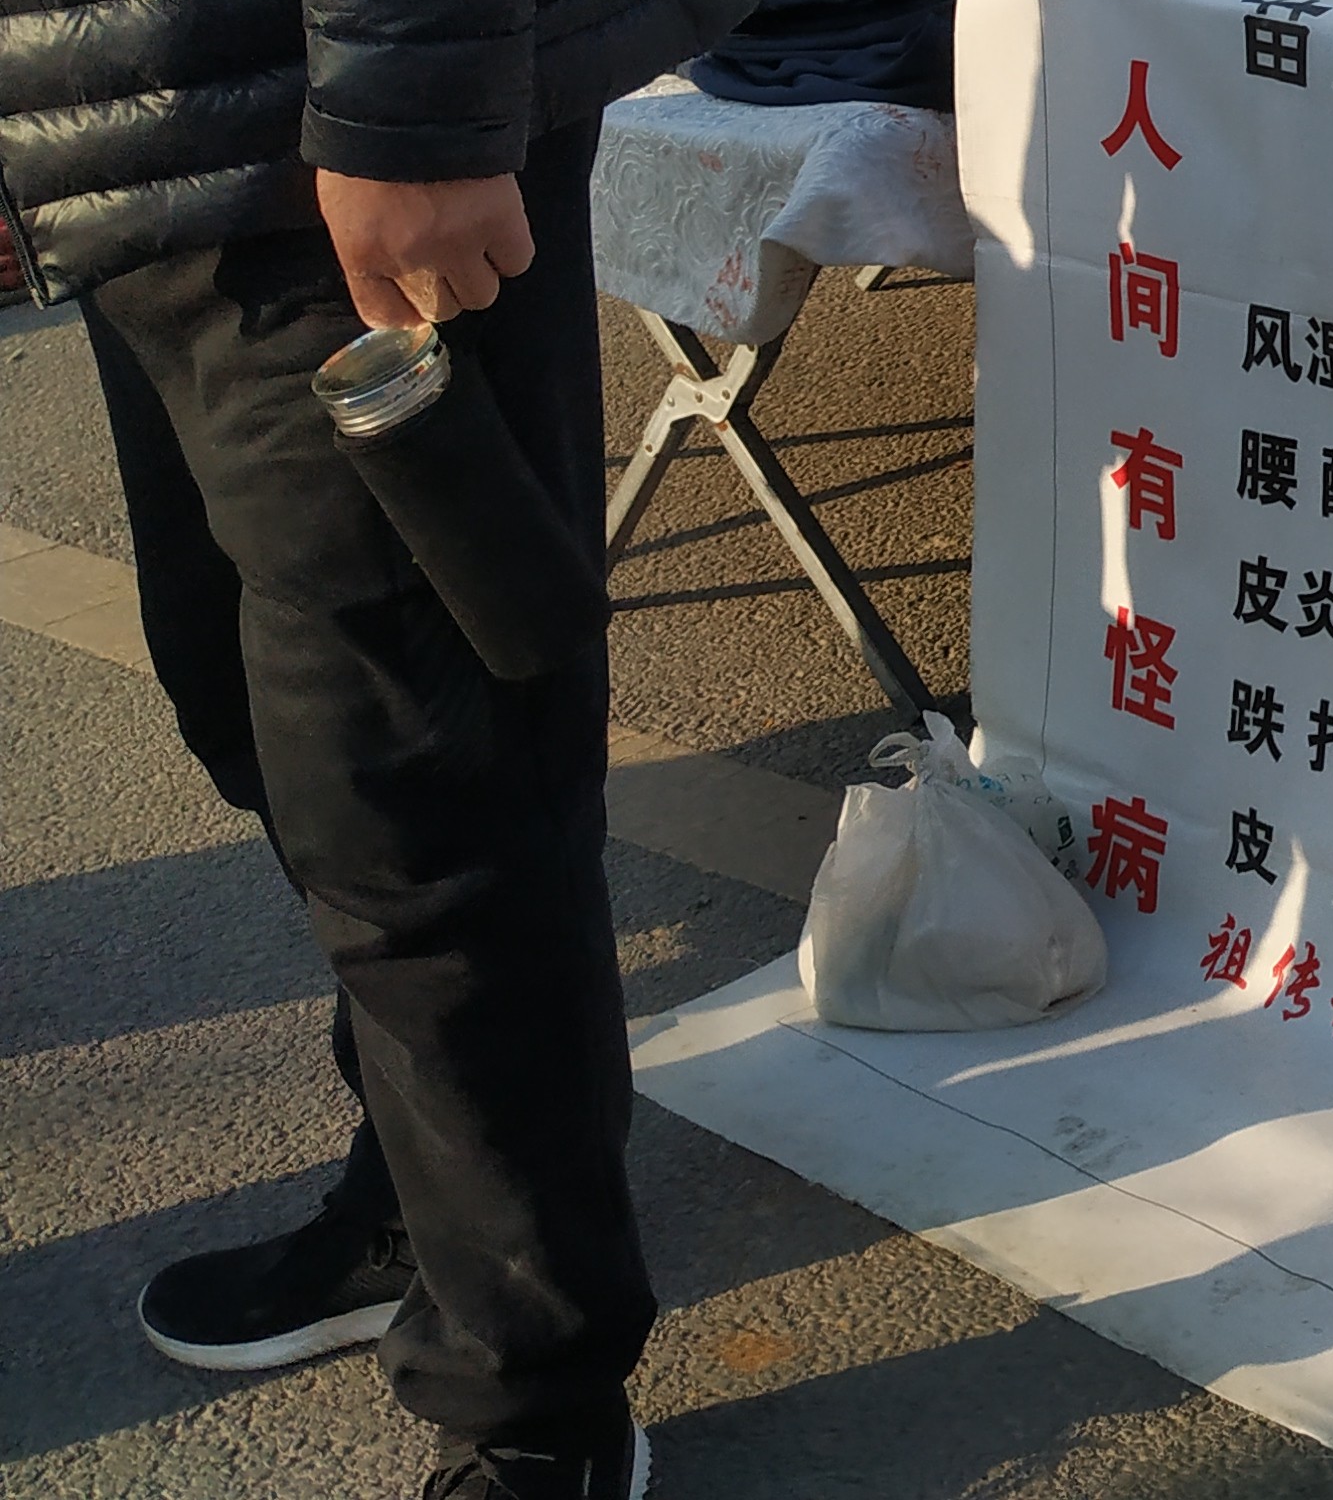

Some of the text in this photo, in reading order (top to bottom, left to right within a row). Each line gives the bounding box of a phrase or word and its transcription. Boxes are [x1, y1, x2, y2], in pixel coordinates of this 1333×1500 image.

[1086, 59, 1183, 914] 人间有怪病
